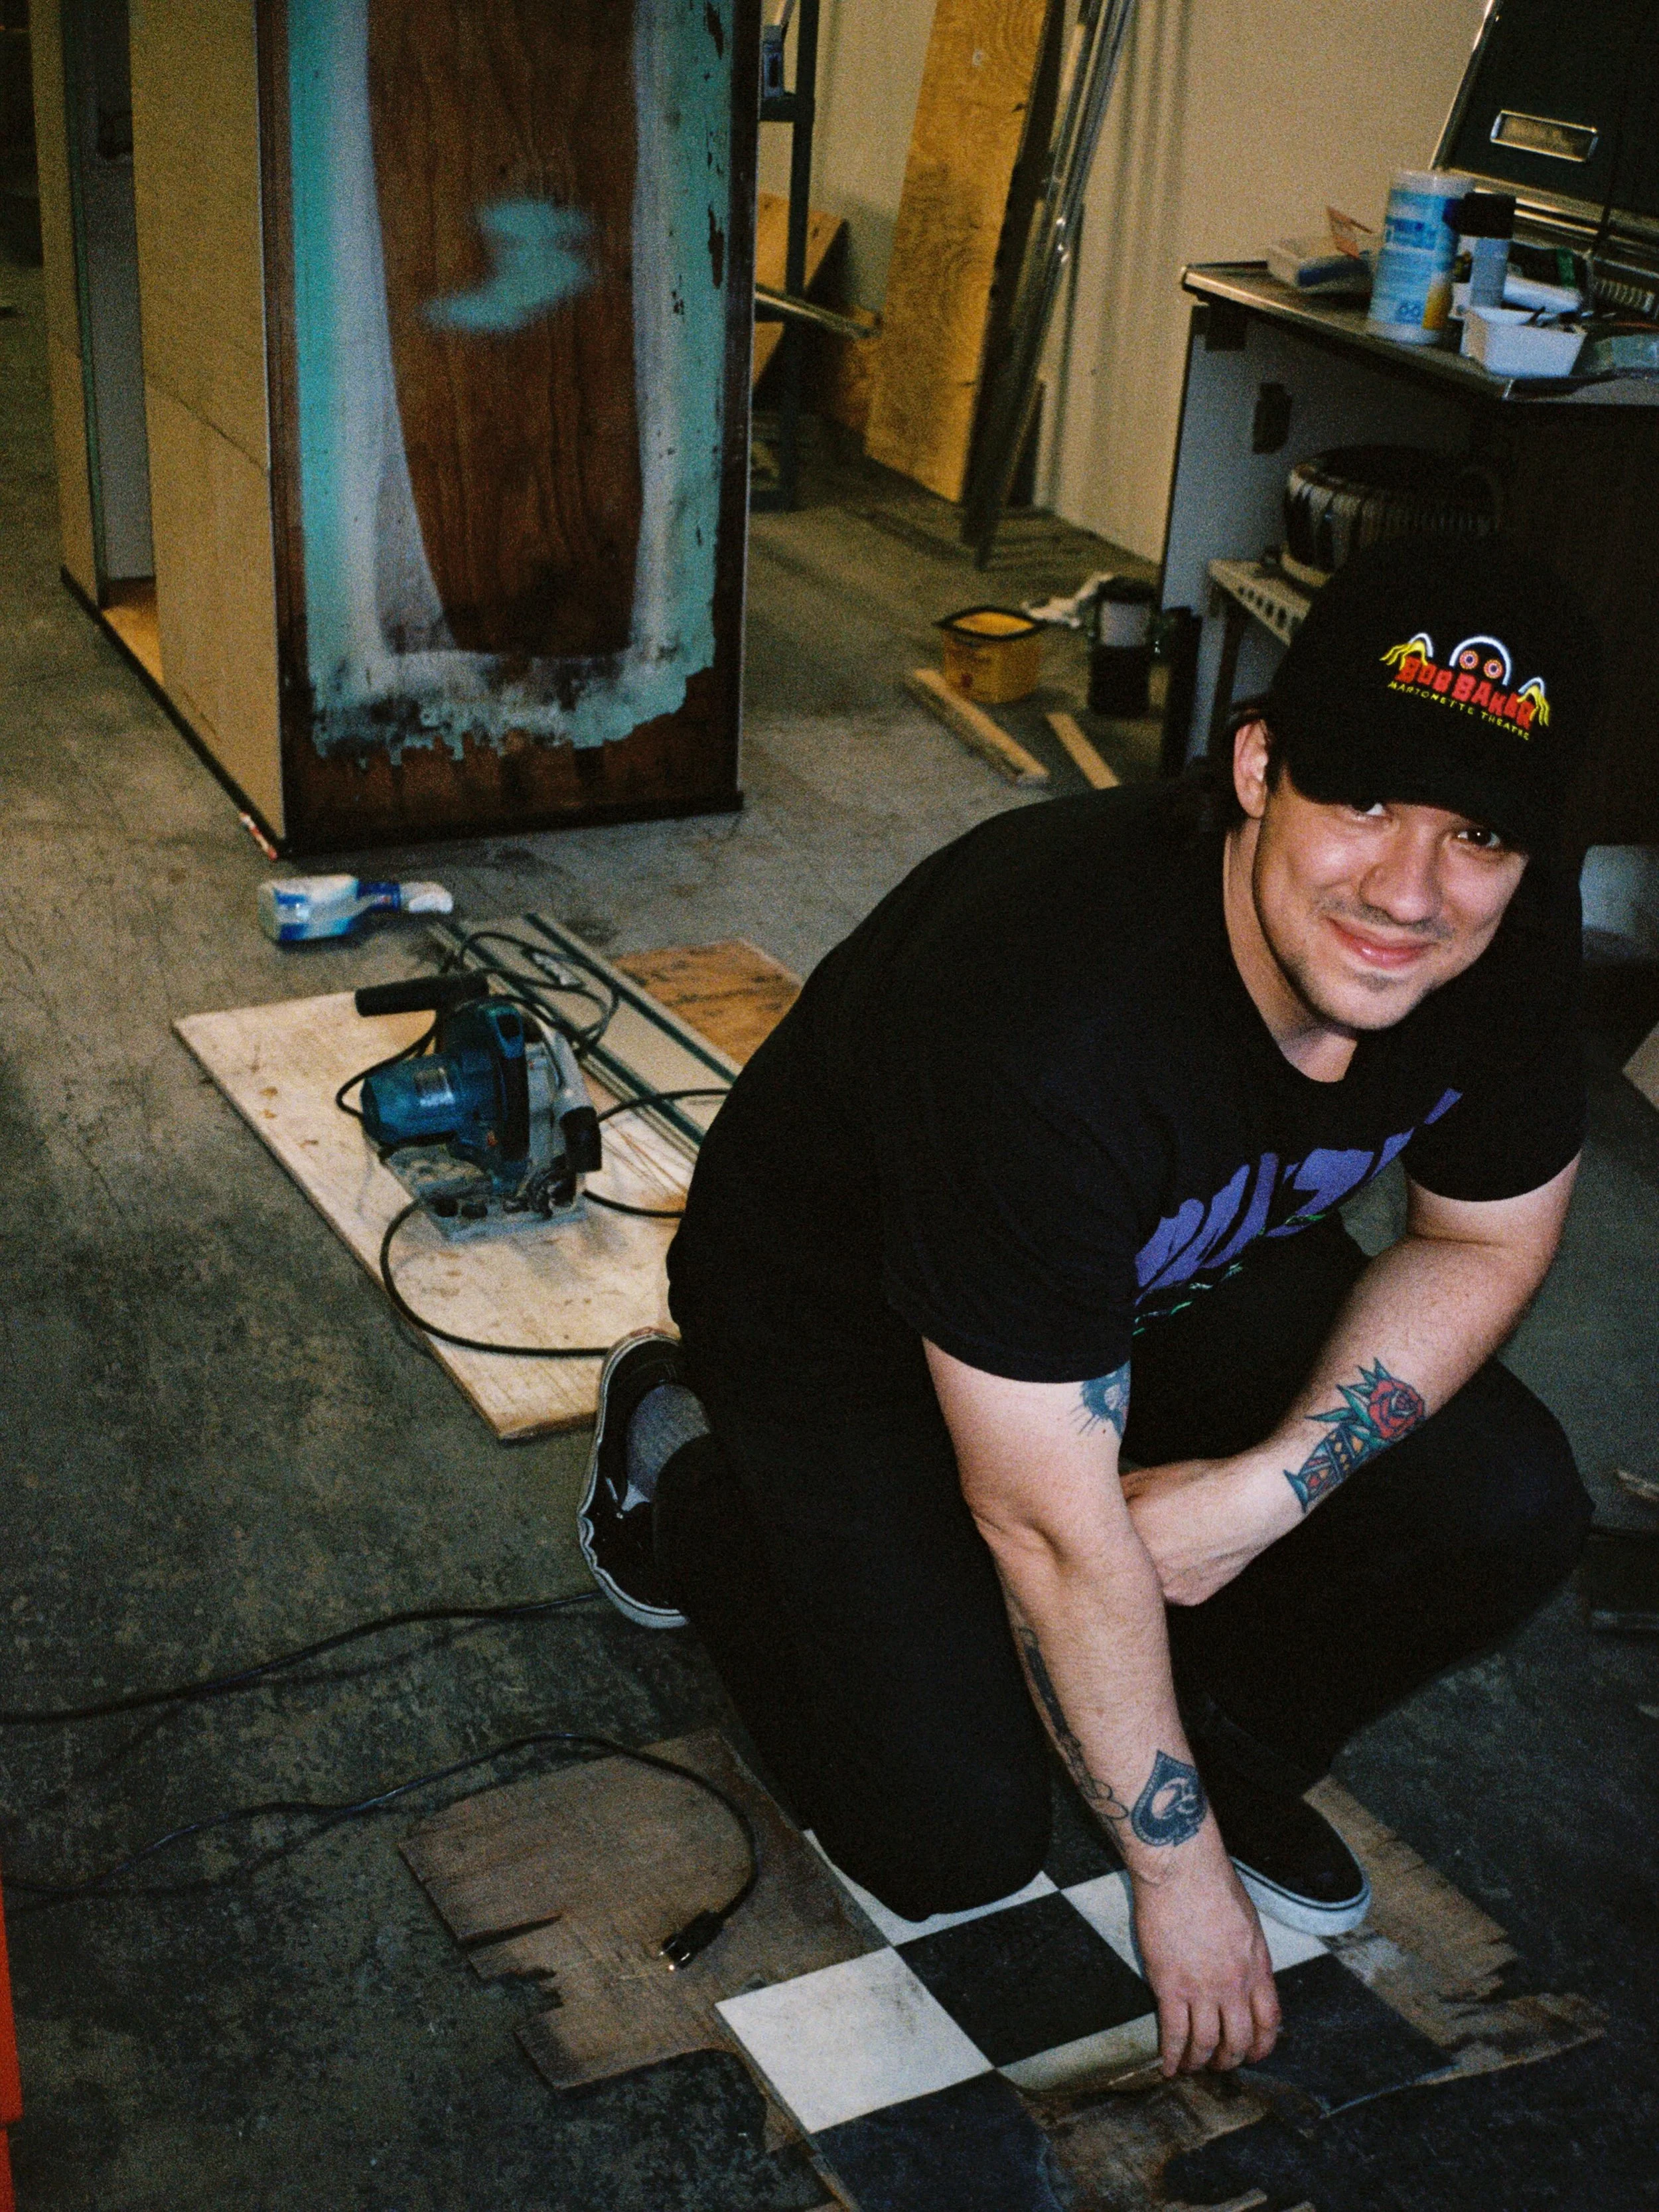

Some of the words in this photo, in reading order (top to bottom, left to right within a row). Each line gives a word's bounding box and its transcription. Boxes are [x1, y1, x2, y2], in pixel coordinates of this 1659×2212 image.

[1388, 681, 1474, 715] MARIONETTE
[1481, 711, 1530, 741] THEATRE
[1395, 655, 1453, 694] BOB
[1451, 671, 1535, 731] BAKER
